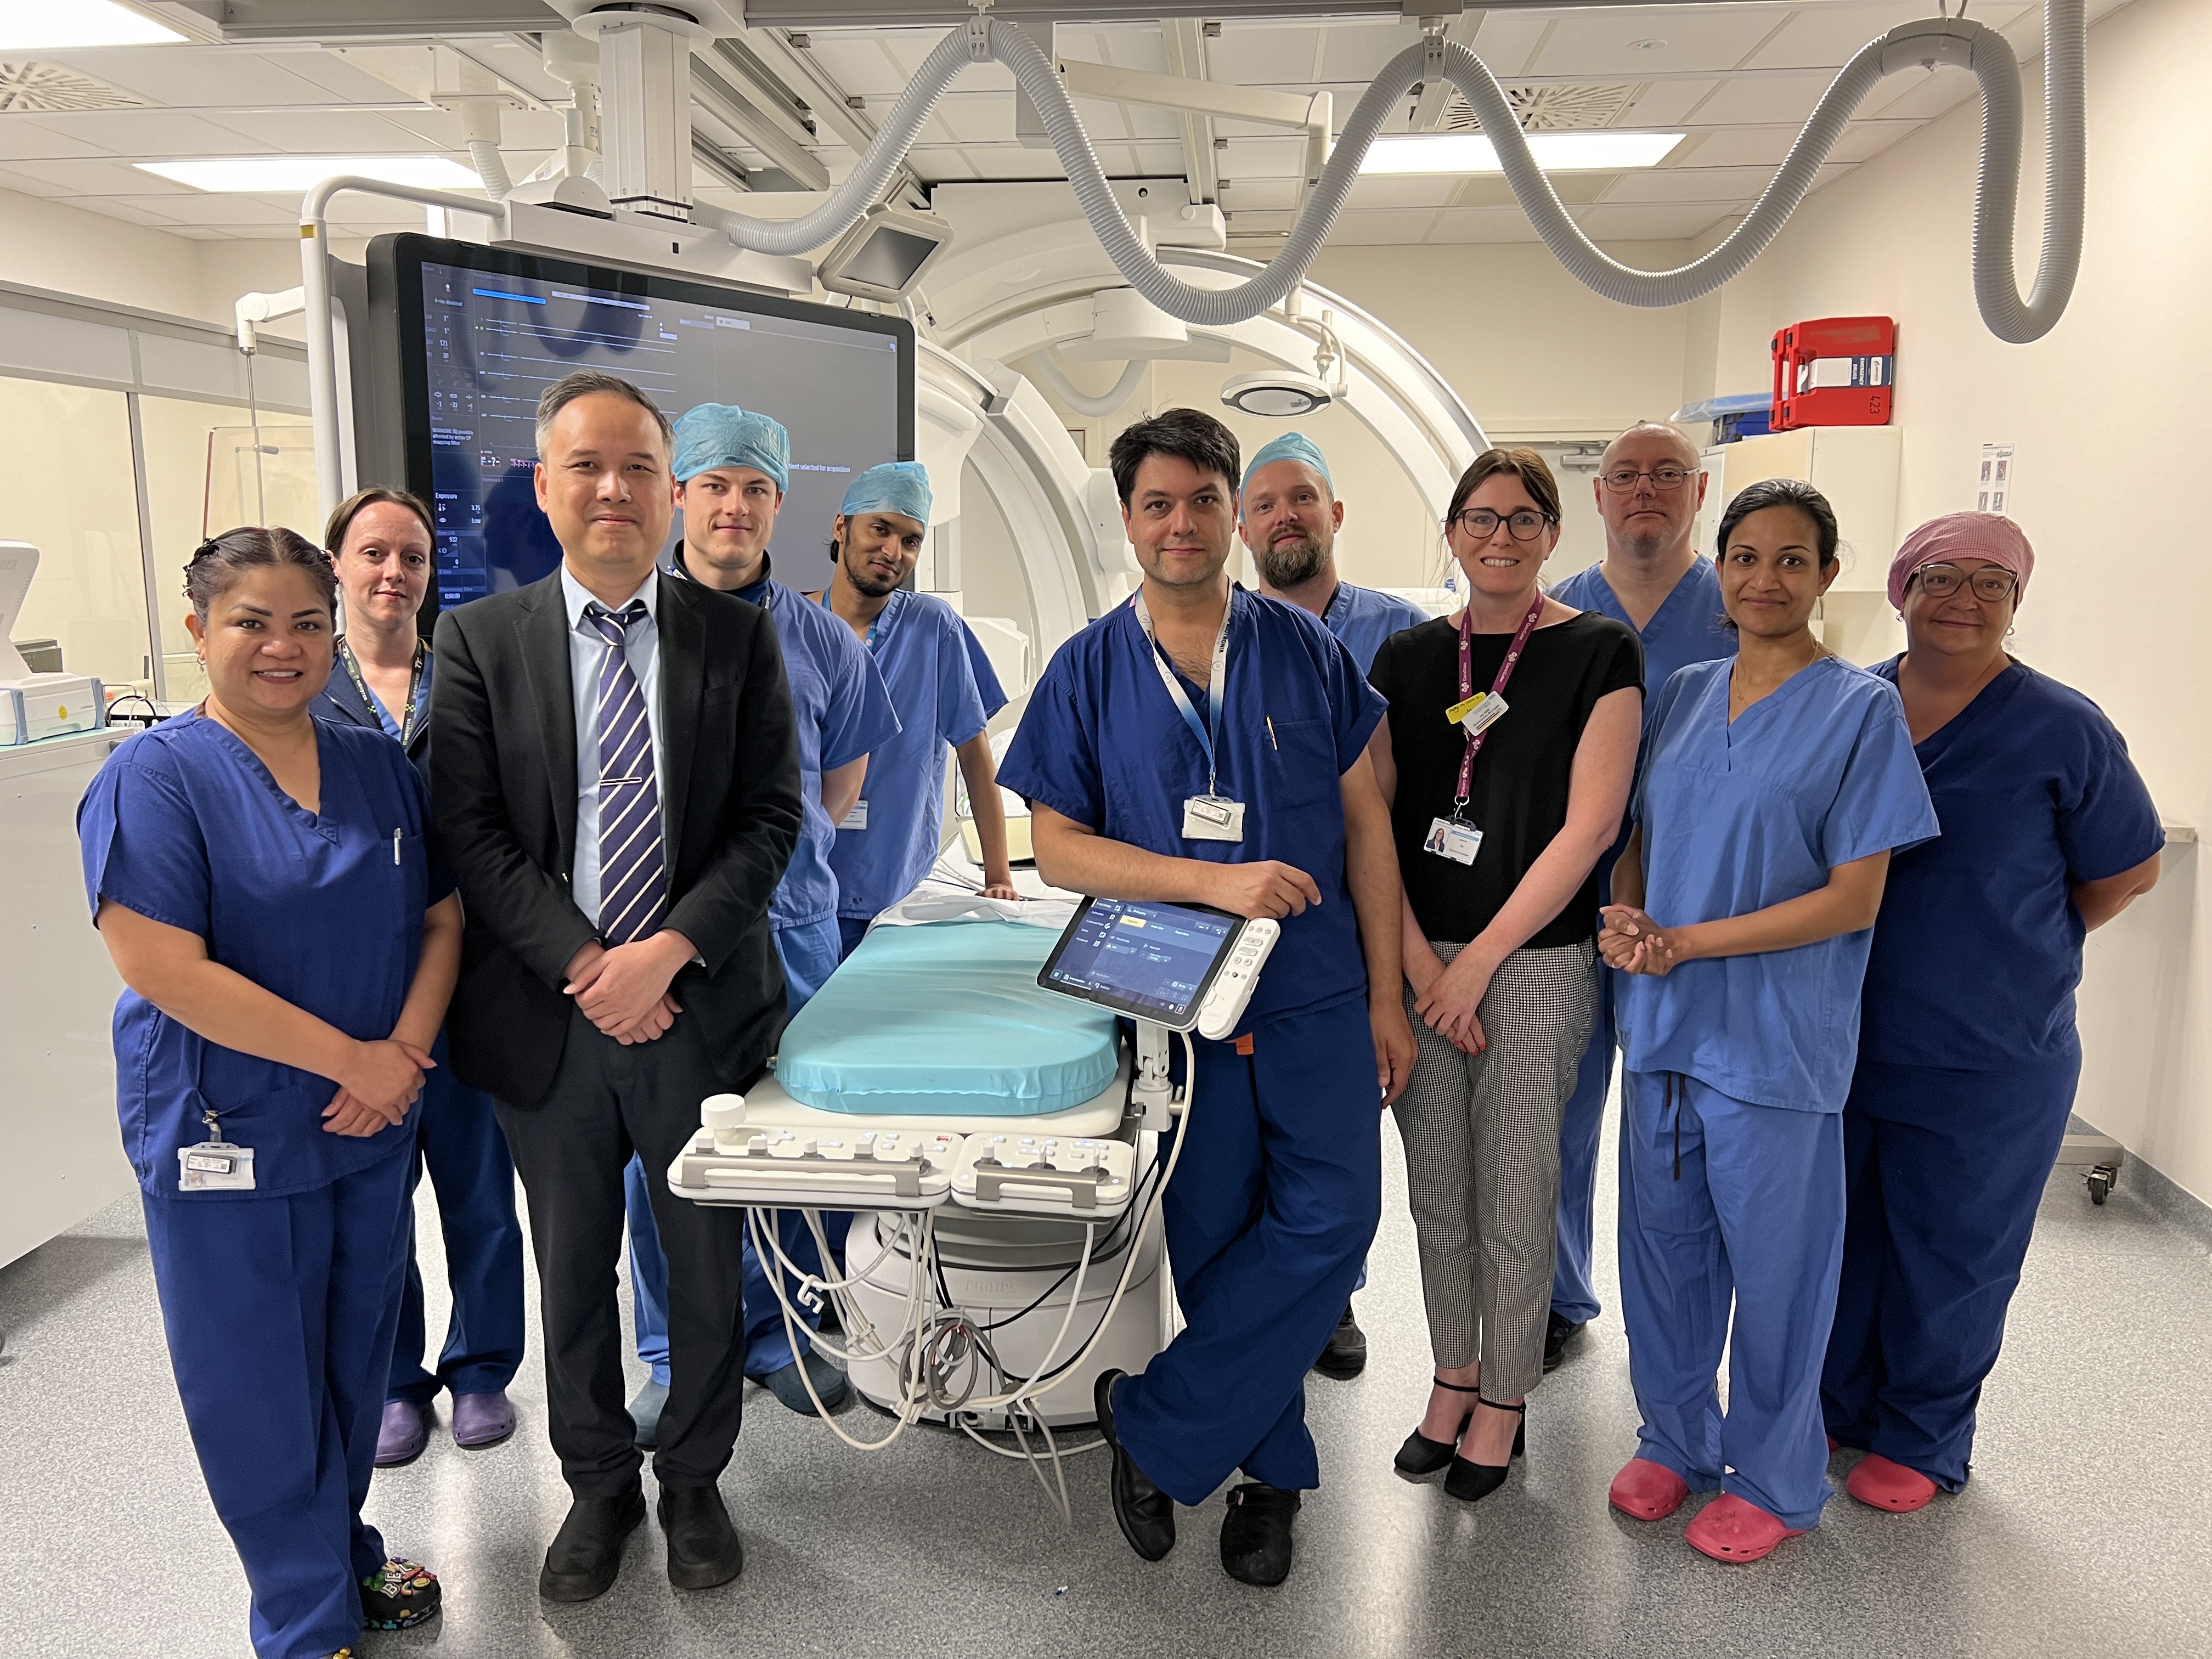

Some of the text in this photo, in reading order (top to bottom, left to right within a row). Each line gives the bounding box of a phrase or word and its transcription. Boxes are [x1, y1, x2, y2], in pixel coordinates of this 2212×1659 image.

[1870, 396, 1881, 414] 423
[1499, 662, 1511, 682] CareCube
[966, 1281, 1018, 1293] PHILIPS
